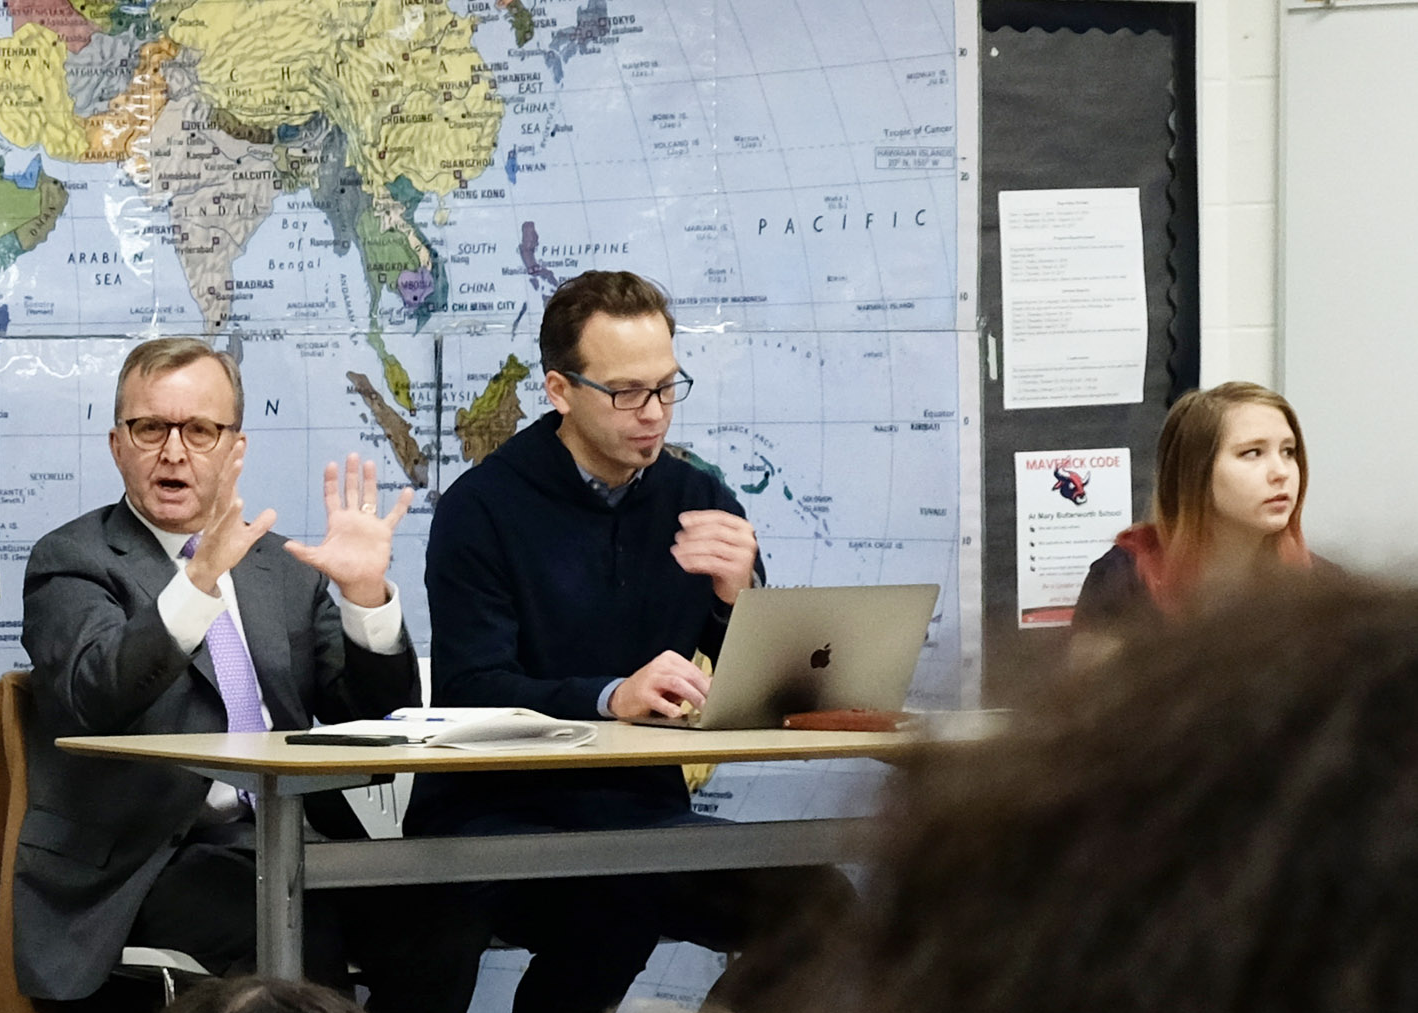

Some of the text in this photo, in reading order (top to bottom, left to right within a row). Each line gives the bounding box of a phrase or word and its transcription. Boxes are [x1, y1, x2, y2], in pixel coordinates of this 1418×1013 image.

[2, 48, 37, 57] TEHRAN
[958, 48, 967, 57] 30
[230, 60, 448, 82] CHINA
[518, 82, 544, 94] EAST
[513, 102, 548, 114] CHINA
[191, 122, 218, 131] DELHI
[520, 123, 541, 135] SEA
[884, 124, 953, 139] Tropic of Cancer
[233, 171, 278, 181] CALCUTTA
[453, 188, 505, 200] HONG KONG
[184, 205, 260, 217] INDIA
[281, 219, 308, 232] Bay
[758, 208, 926, 235] PACIFIC
[288, 237, 302, 250] of
[458, 243, 497, 255] SOUTH
[542, 242, 630, 256] PHILIPPINE
[67, 252, 143, 264] ARABIN
[268, 258, 321, 273] Bengal
[95, 273, 122, 286] SEA
[235, 280, 274, 289] MADRAS
[459, 282, 496, 295] CHINA
[496, 301, 516, 311] CITY
[1089, 455, 1121, 468] CODE
